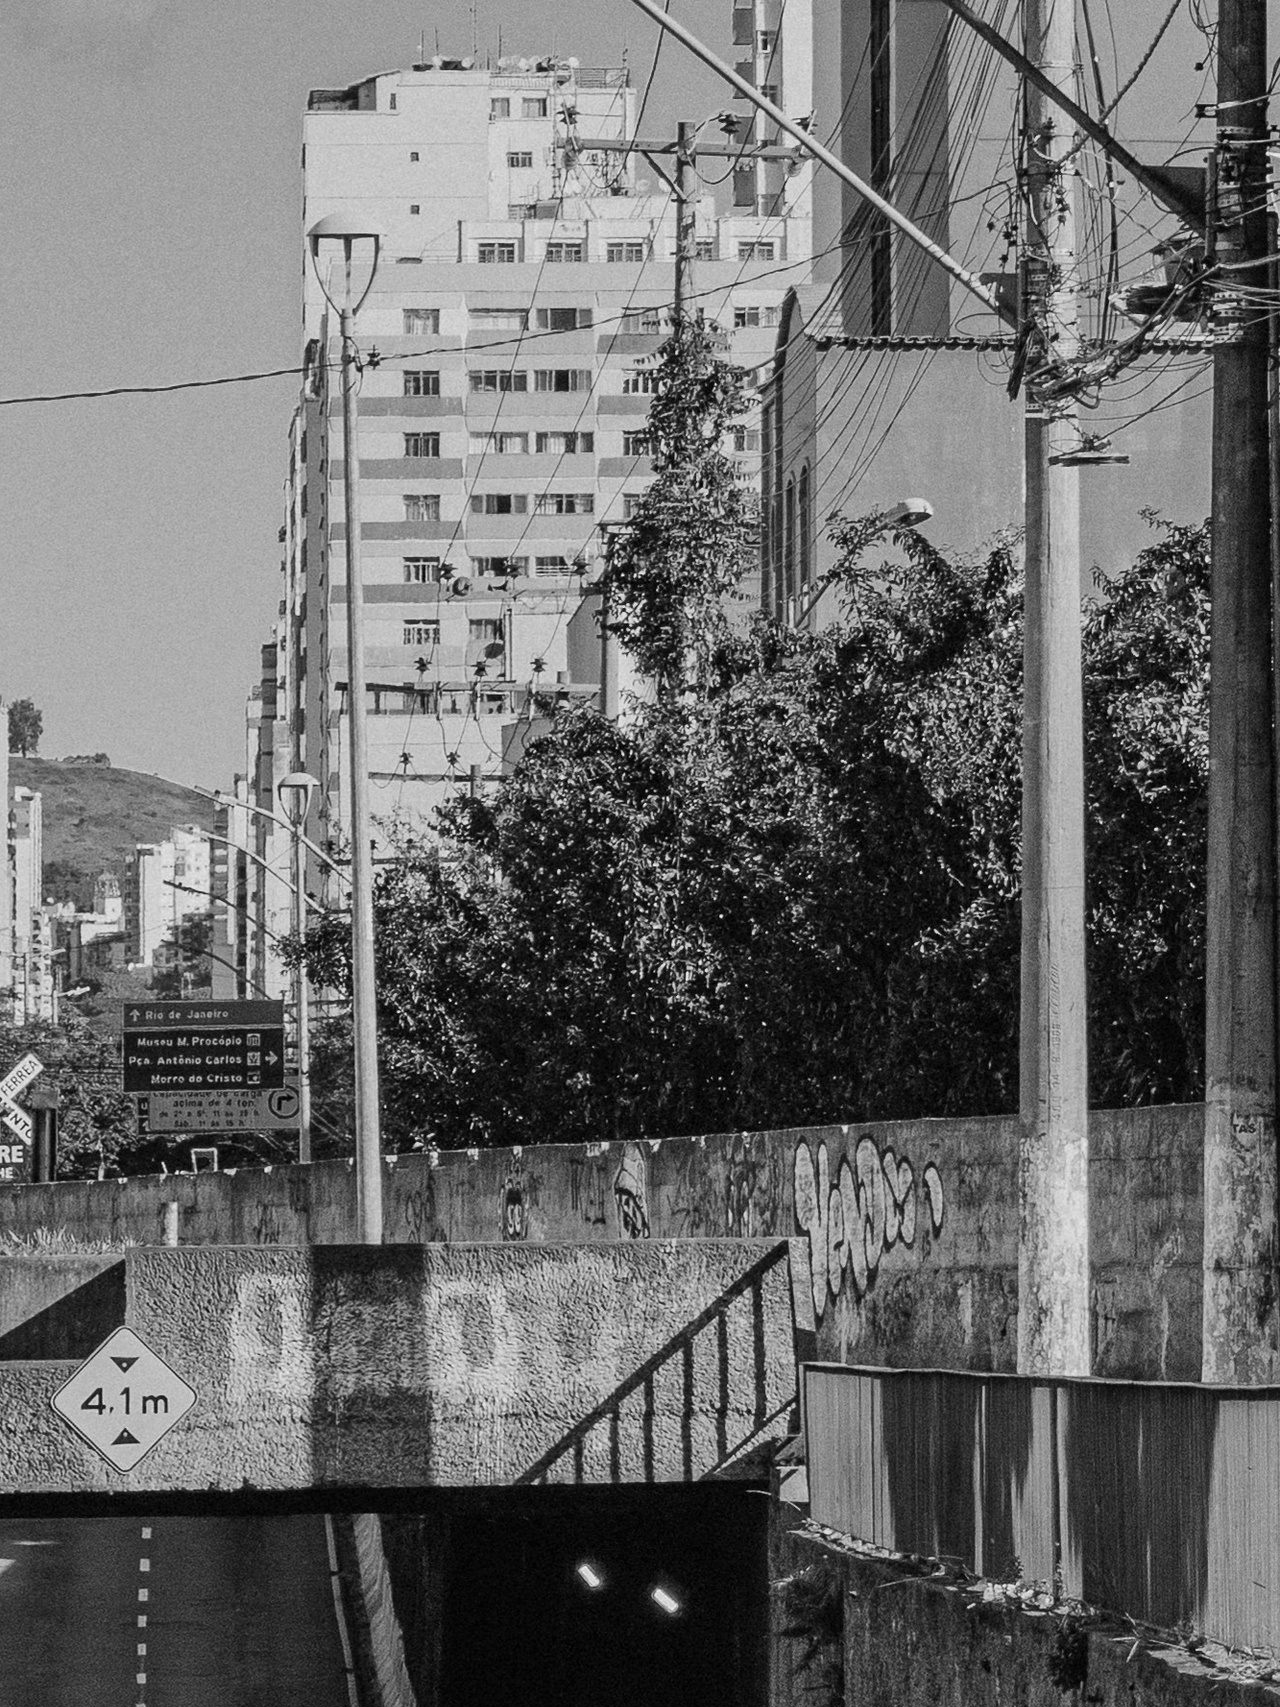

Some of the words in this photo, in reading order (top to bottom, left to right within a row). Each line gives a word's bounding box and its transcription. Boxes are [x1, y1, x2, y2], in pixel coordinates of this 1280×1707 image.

[145, 1009, 164, 1020] Rio
[168, 1009, 181, 1019] de
[187, 1008, 229, 1019] Janeiro
[137, 1037, 173, 1047] Museu
[191, 1035, 242, 1047] Procópio
[157, 1054, 202, 1066] Antônio
[205, 1055, 242, 1065] Carlos
[151, 1074, 185, 1084] Morro
[188, 1074, 203, 1083] do
[206, 1073, 242, 1083] Cristo
[173, 1099, 203, 1107] acima
[208, 1099, 220, 1107] de
